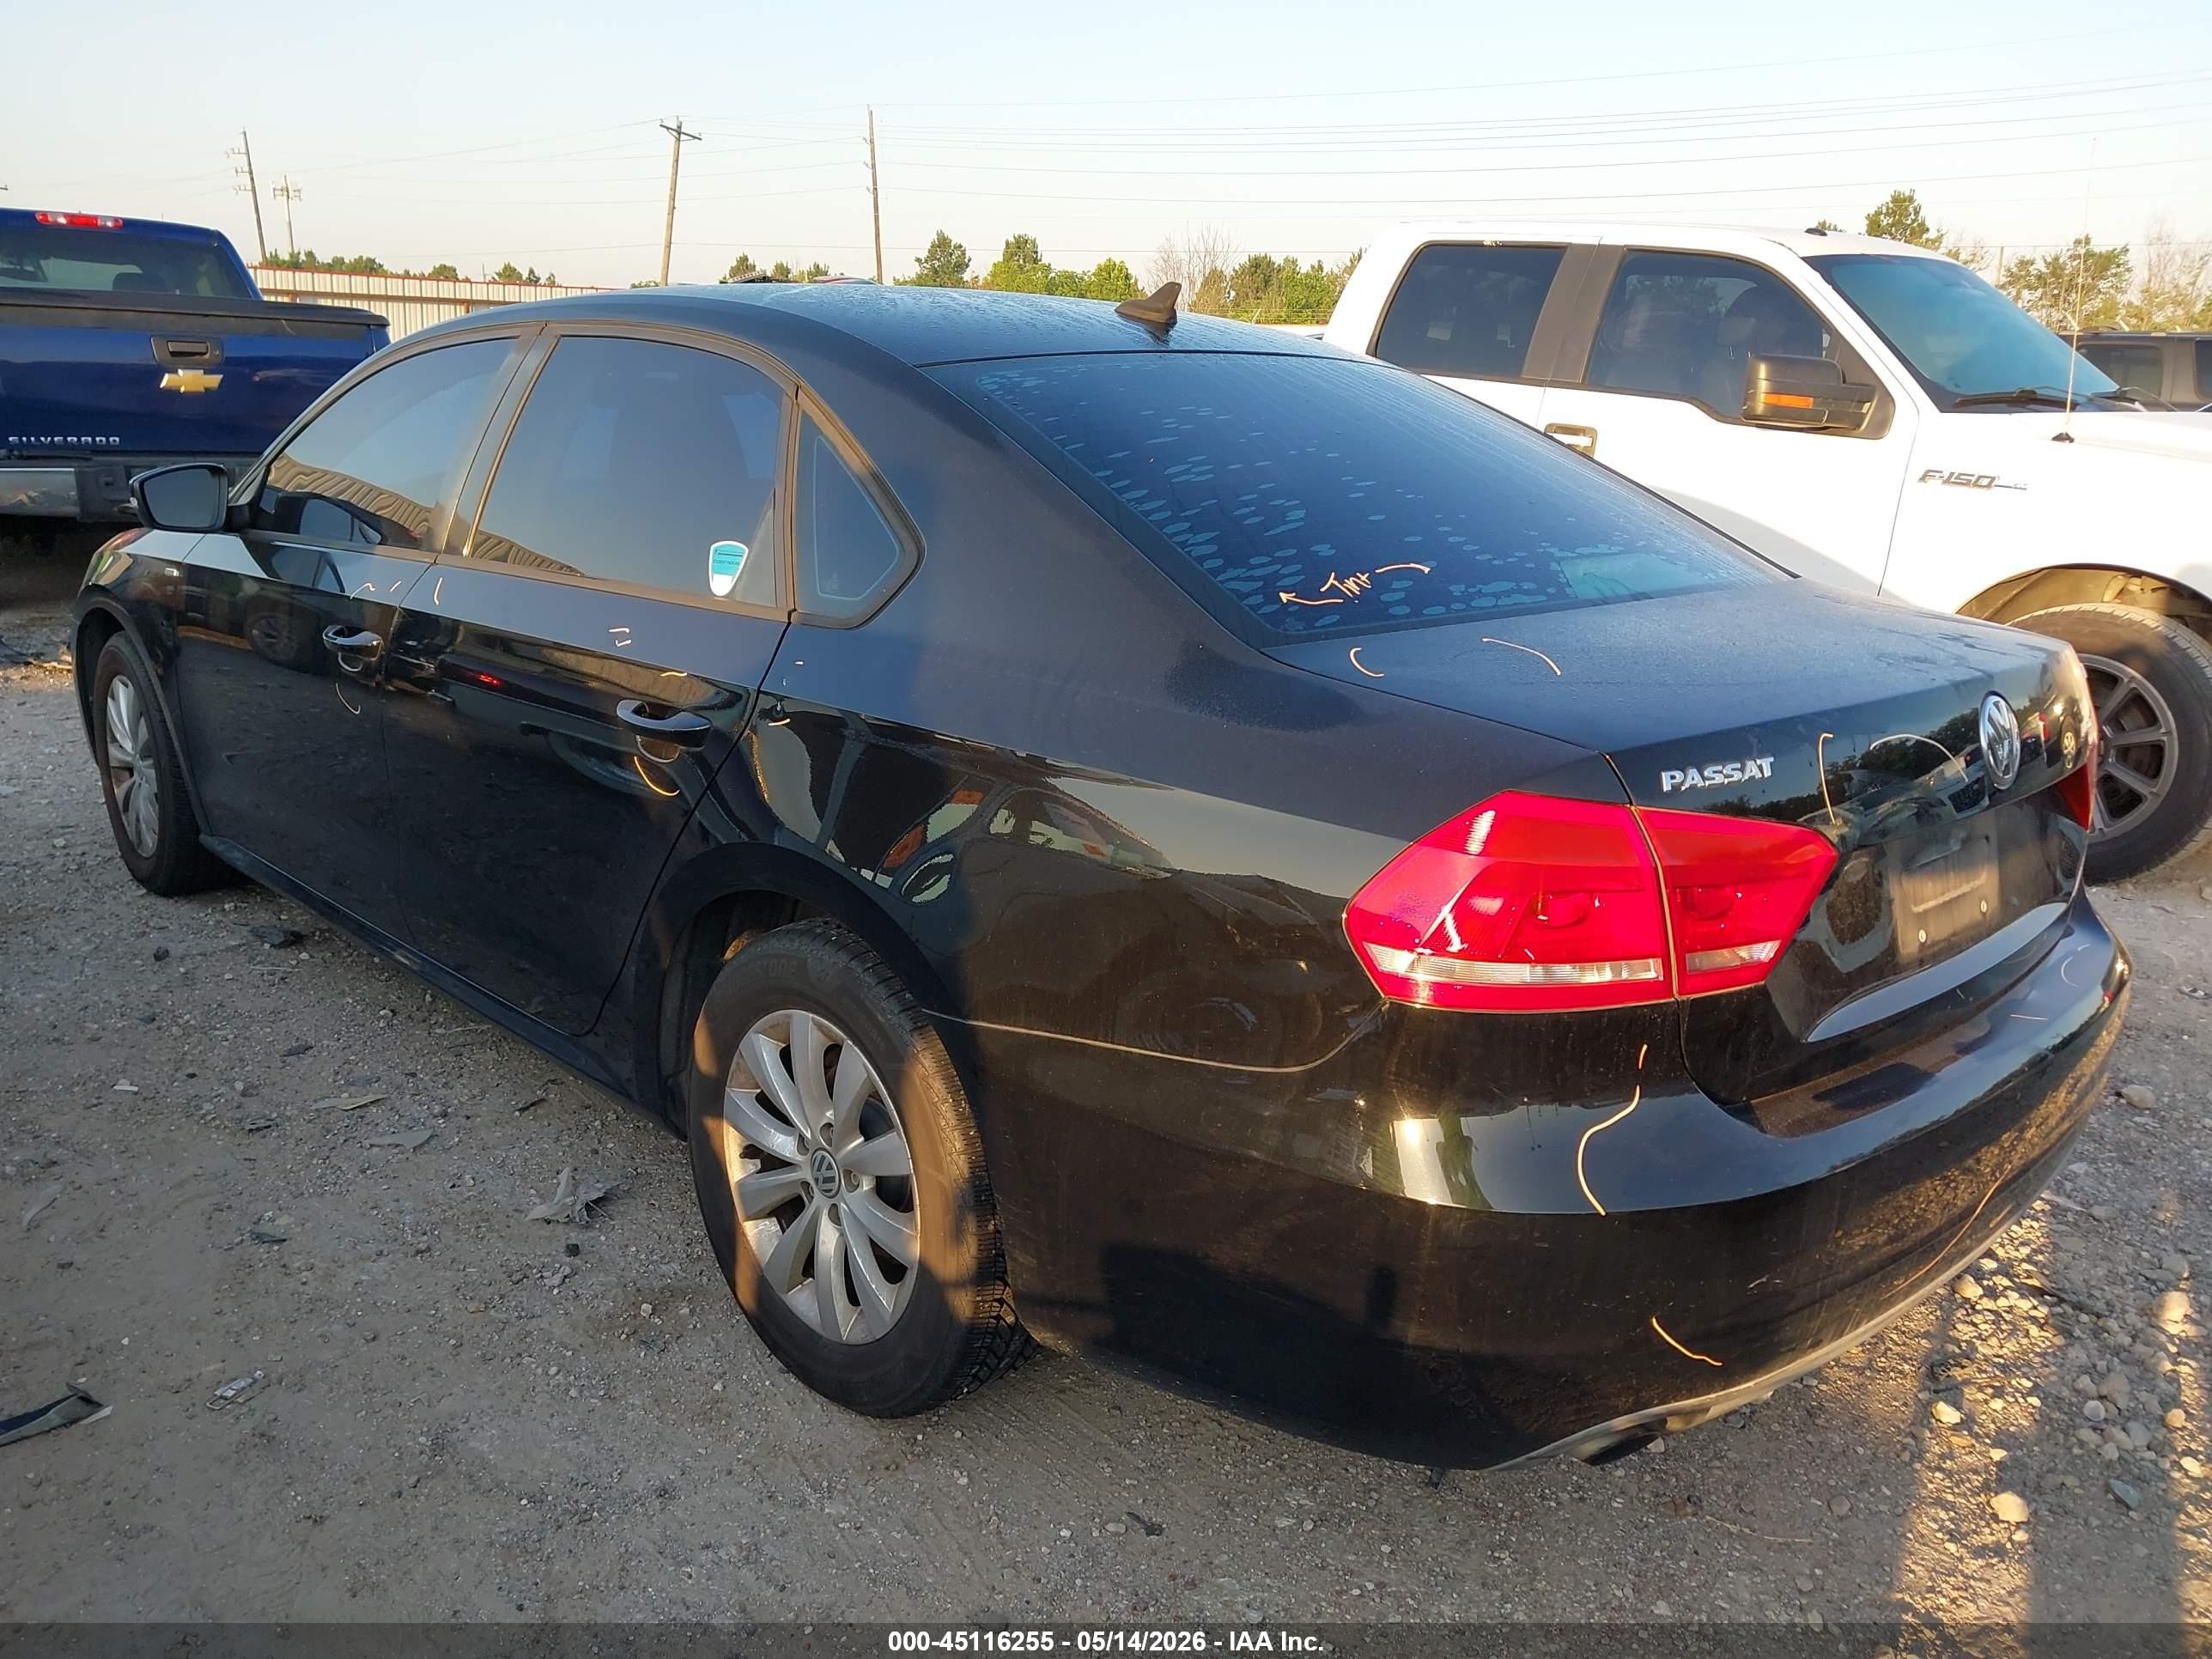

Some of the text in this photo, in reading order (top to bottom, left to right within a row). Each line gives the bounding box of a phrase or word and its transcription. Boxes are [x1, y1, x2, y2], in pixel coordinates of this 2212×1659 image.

[8, 435, 120, 446] SILVERADO
[1918, 469, 1996, 490] F-150
[1661, 757, 1775, 793] PASSAT
